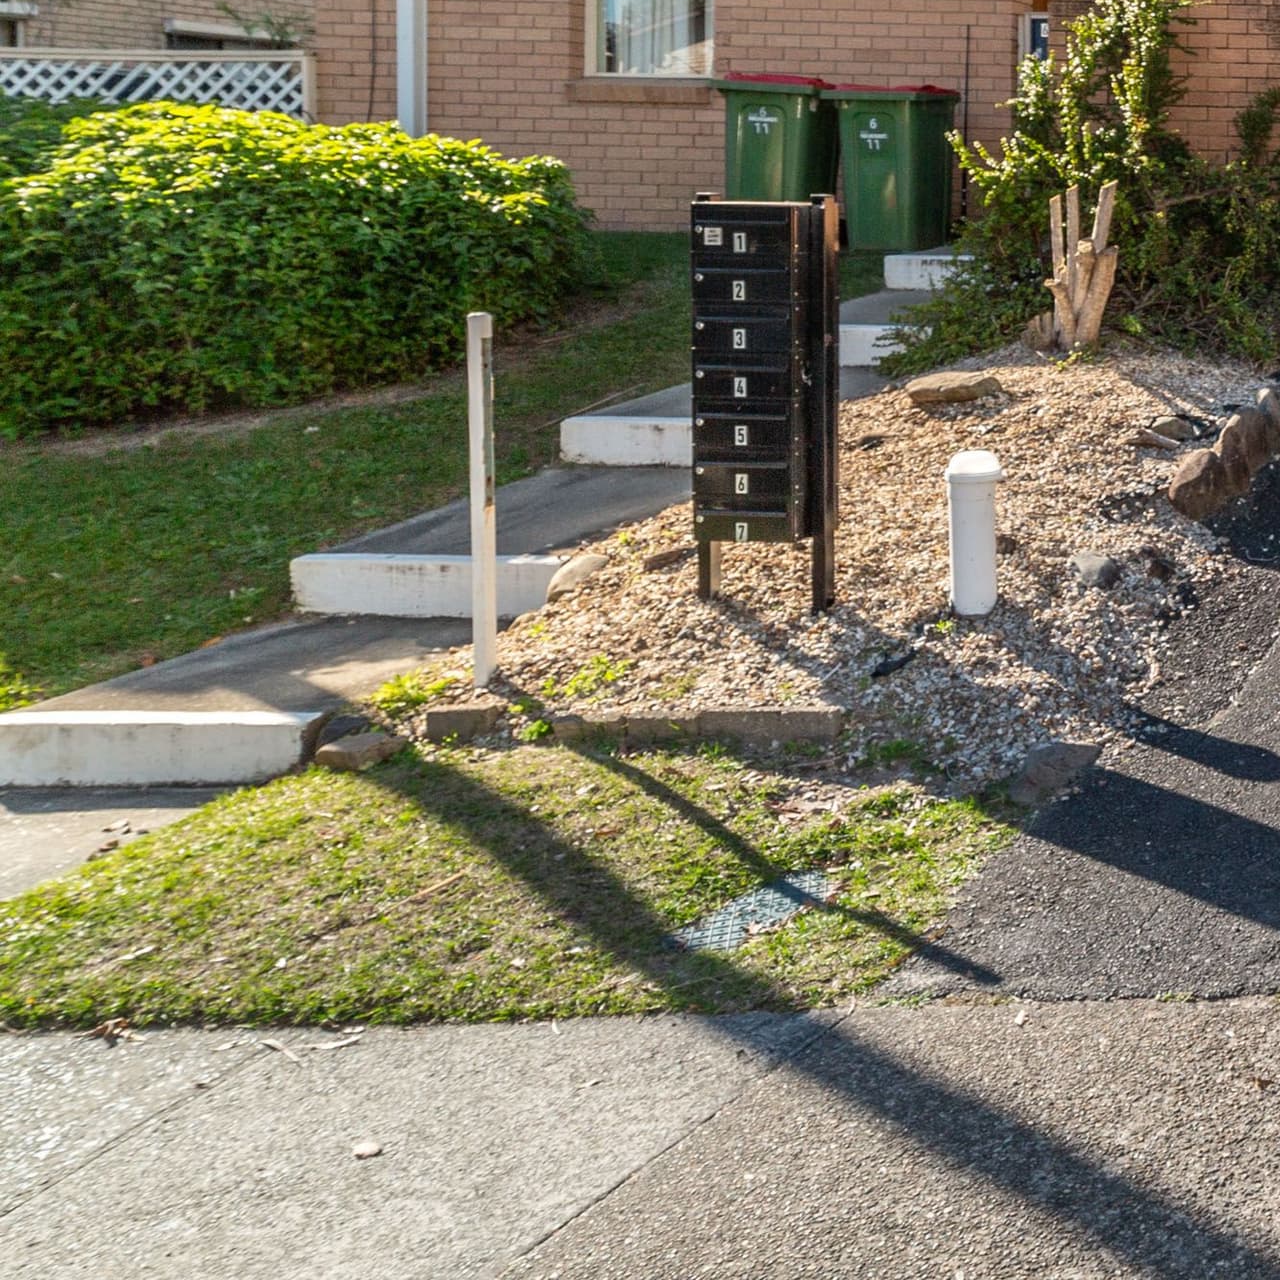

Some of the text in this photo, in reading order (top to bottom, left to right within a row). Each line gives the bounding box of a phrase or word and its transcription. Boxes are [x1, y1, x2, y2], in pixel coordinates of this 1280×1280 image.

[754, 122, 769, 135] 11
[869, 117, 878, 129] 6
[866, 139, 880, 150] 11
[735, 282, 743, 299] 2
[735, 331, 743, 347] 3
[736, 379, 744, 395] 4
[737, 427, 745, 444] 5
[737, 476, 745, 492] 6
[738, 524, 745, 540] 7
